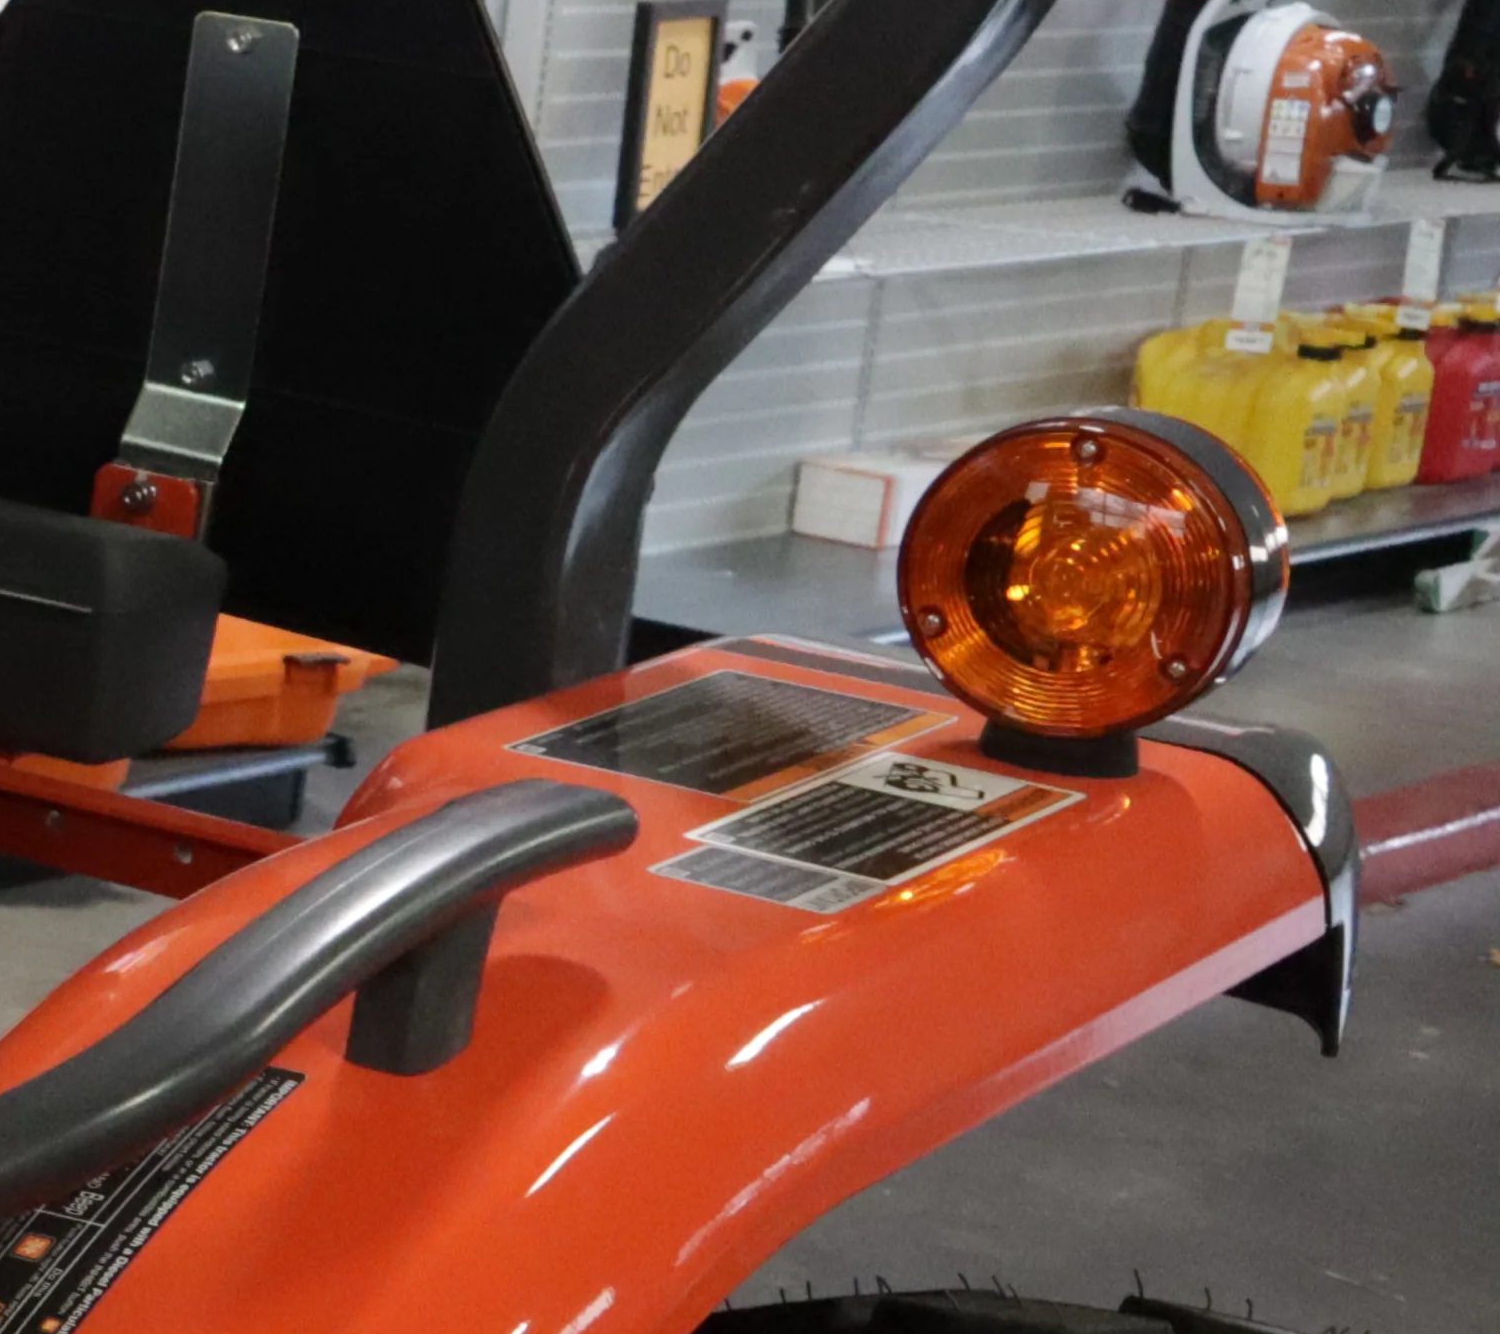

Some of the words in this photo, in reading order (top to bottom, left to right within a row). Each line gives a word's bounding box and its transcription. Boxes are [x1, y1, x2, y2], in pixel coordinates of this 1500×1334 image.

[664, 45, 691, 78] Do
[655, 104, 689, 135] Not
[640, 163, 670, 196] En
[241, 1079, 297, 1126] IMPORTANT:
[220, 1128, 246, 1146] This
[193, 1145, 228, 1173] tractor
[61, 1188, 105, 1219] Beep
[146, 1184, 190, 1226] equipped
[128, 1228, 153, 1246] with
[96, 1255, 130, 1285] Diesel
